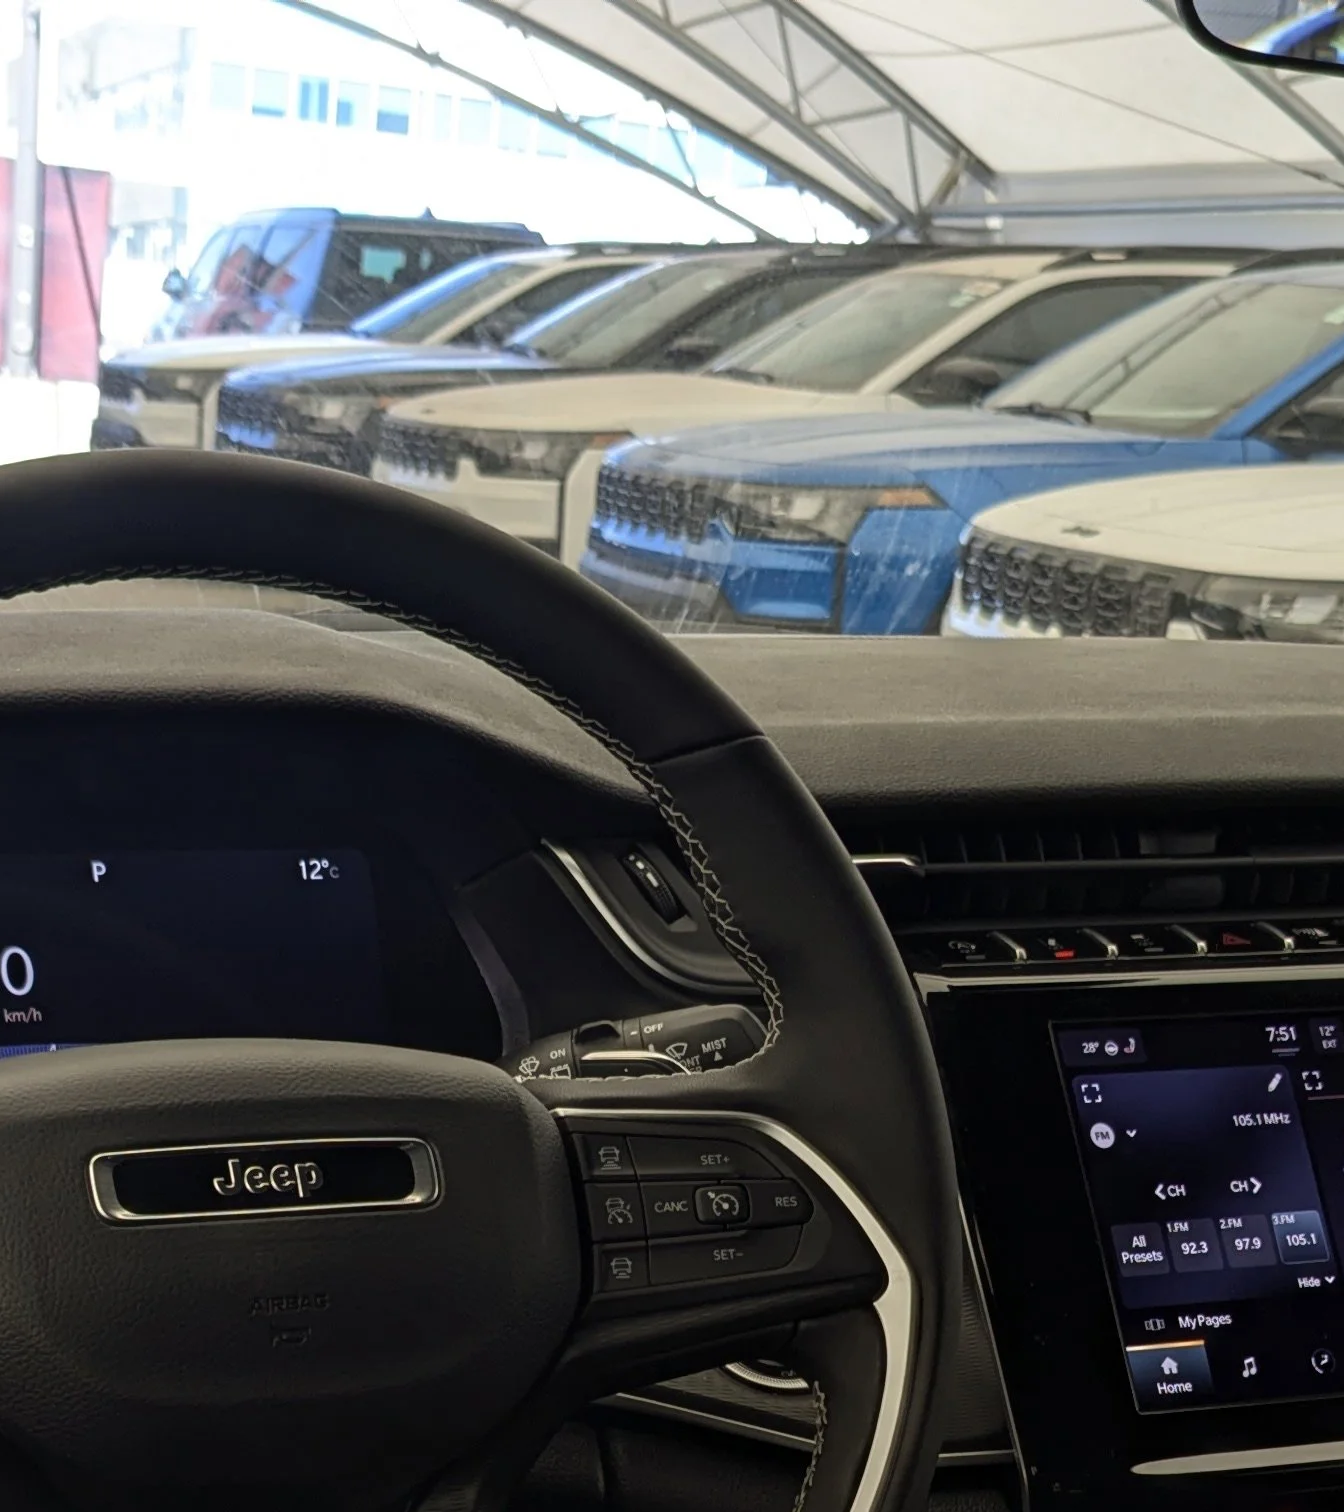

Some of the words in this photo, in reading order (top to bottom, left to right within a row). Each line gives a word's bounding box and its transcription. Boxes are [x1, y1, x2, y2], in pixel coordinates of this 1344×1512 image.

[90, 859, 106, 882] P
[0, 945, 35, 996] 0
[3, 1006, 43, 1023] km/h
[643, 1022, 664, 1034] OFF
[1265, 1025, 1298, 1043] 7:51
[1319, 1025, 1337, 1037] 12°
[701, 1037, 727, 1054] MIST
[549, 1048, 566, 1060] ON
[1232, 1113, 1261, 1127] 105.1
[1263, 1112, 1292, 1125] MHz
[1094, 1131, 1111, 1141] FM
[212, 1158, 324, 1198] Jeep
[1167, 1184, 1187, 1197] CH
[1230, 1180, 1249, 1193] CH
[654, 1200, 688, 1213] CANC
[774, 1196, 798, 1207] RES
[1131, 1235, 1146, 1248] All
[1234, 1237, 1261, 1251] 97.9
[1285, 1233, 1317, 1247] 105.1
[1181, 1241, 1208, 1255] 92.3
[1121, 1251, 1163, 1264] Presets
[1297, 1277, 1321, 1289] Hide
[1178, 1316, 1197, 1330] My
[1197, 1314, 1232, 1328] Pages
[1157, 1381, 1193, 1395] Home
